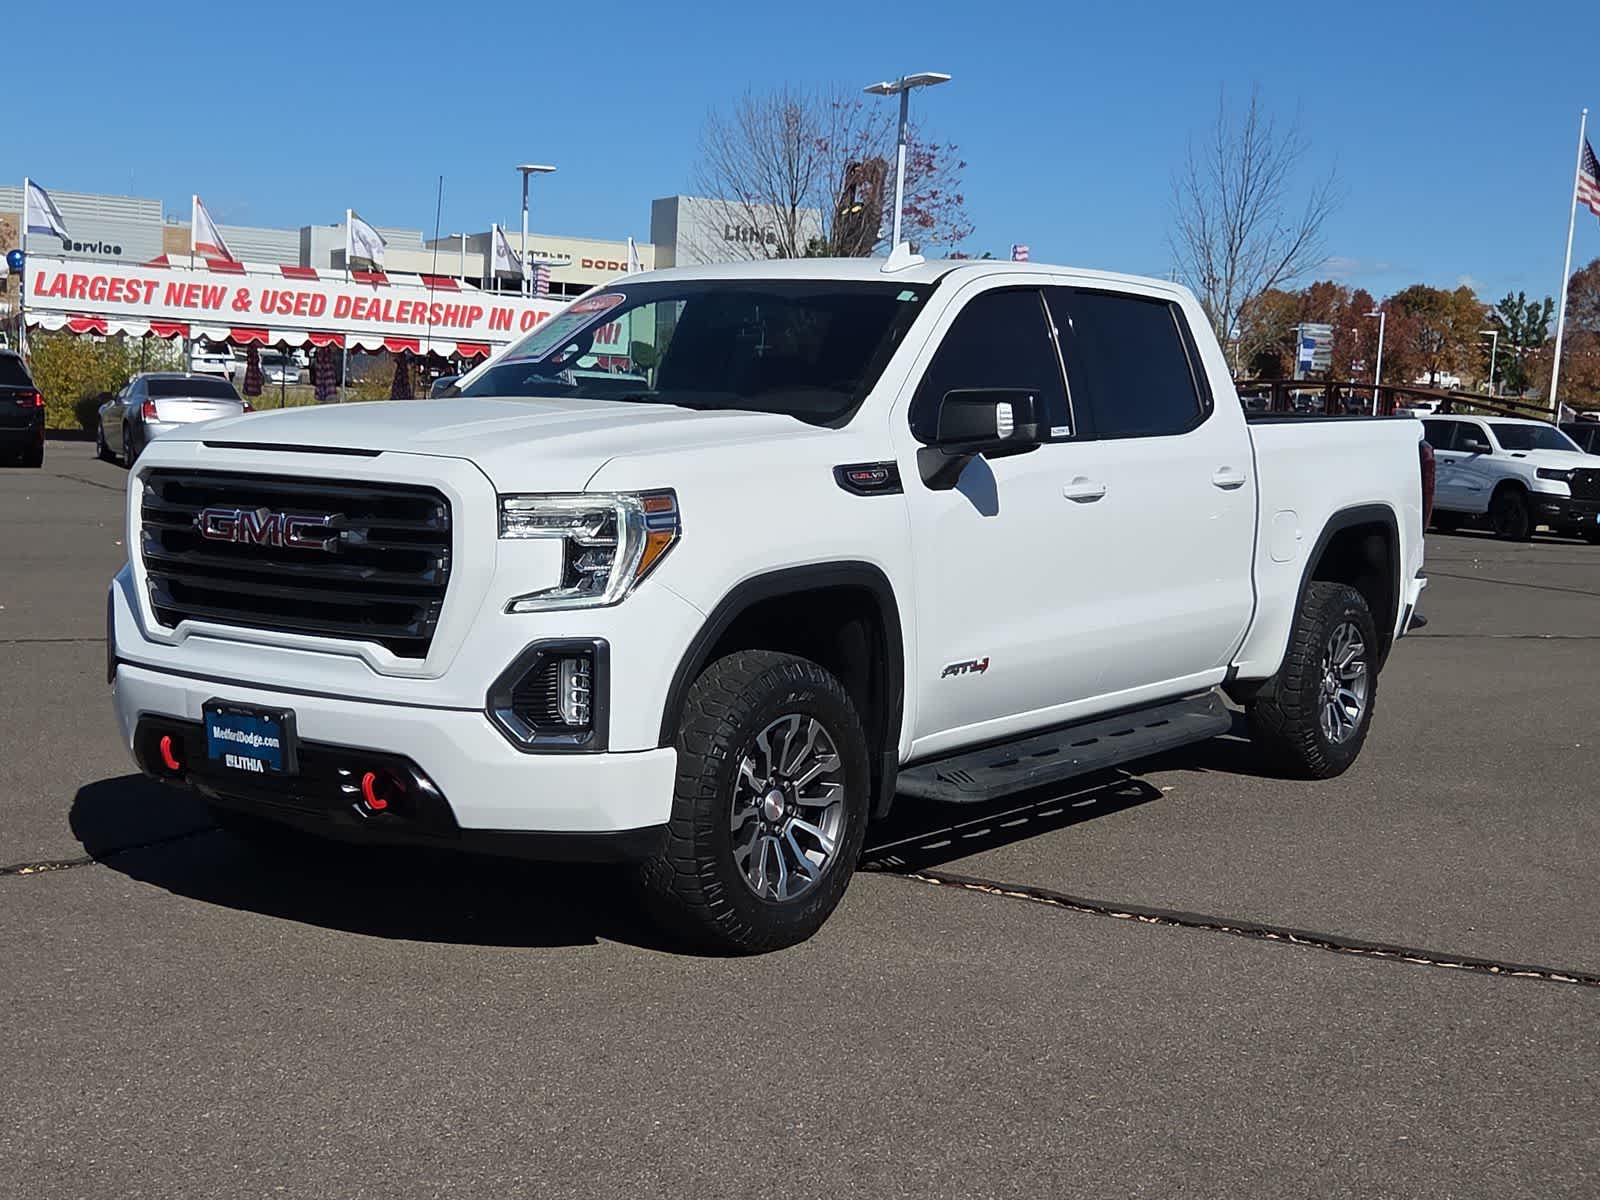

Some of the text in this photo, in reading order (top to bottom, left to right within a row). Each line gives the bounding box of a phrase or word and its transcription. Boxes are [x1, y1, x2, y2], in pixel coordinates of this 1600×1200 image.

[63, 239, 122, 255] Service
[33, 271, 160, 304] LARGEST
[164, 281, 228, 310] NEW
[231, 287, 253, 312] &
[259, 289, 328, 318] USED
[333, 294, 483, 329] DEALERSHIP
[488, 306, 515, 331] IN
[202, 507, 336, 551] GMC
[941, 657, 989, 679] AT4
[213, 725, 280, 748] MedfordDodge.com
